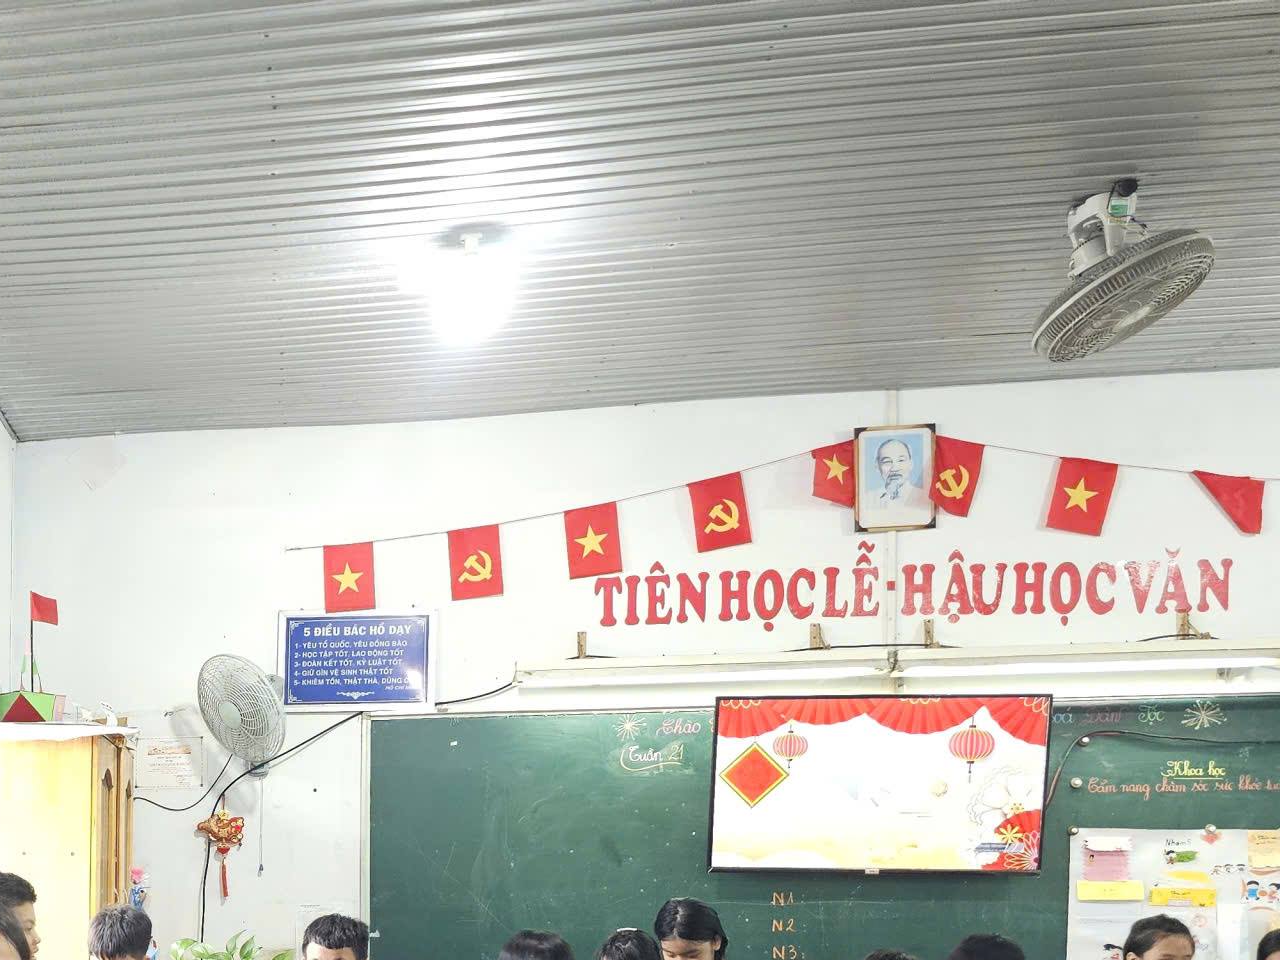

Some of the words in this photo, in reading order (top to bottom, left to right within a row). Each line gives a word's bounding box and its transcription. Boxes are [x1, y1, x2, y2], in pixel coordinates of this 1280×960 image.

[594, 560, 710, 627] TIÊN
[718, 568, 816, 632] HỌC
[821, 540, 880, 618] LỄ
[901, 549, 1008, 624] HẬU
[1011, 561, 1117, 627] HỌC
[1123, 547, 1234, 615] VĂN
[303, 627, 311, 637] 5
[314, 623, 340, 637] ĐIỀU
[343, 624, 367, 636] BÁC
[369, 622, 386, 635] HỒ
[389, 624, 412, 636] DẠY
[302, 641, 317, 649] YÊU
[353, 640, 368, 648] YÊU
[302, 651, 318, 659] HỌC
[390, 648, 404, 656] TỐT
[323, 658, 338, 667] KẾT
[388, 657, 402, 666] TỐT
[379, 666, 393, 675] TỐT
[1160, 760, 1205, 777] Khoa
[1207, 760, 1227, 778] học
[1119, 783, 1152, 801] nang
